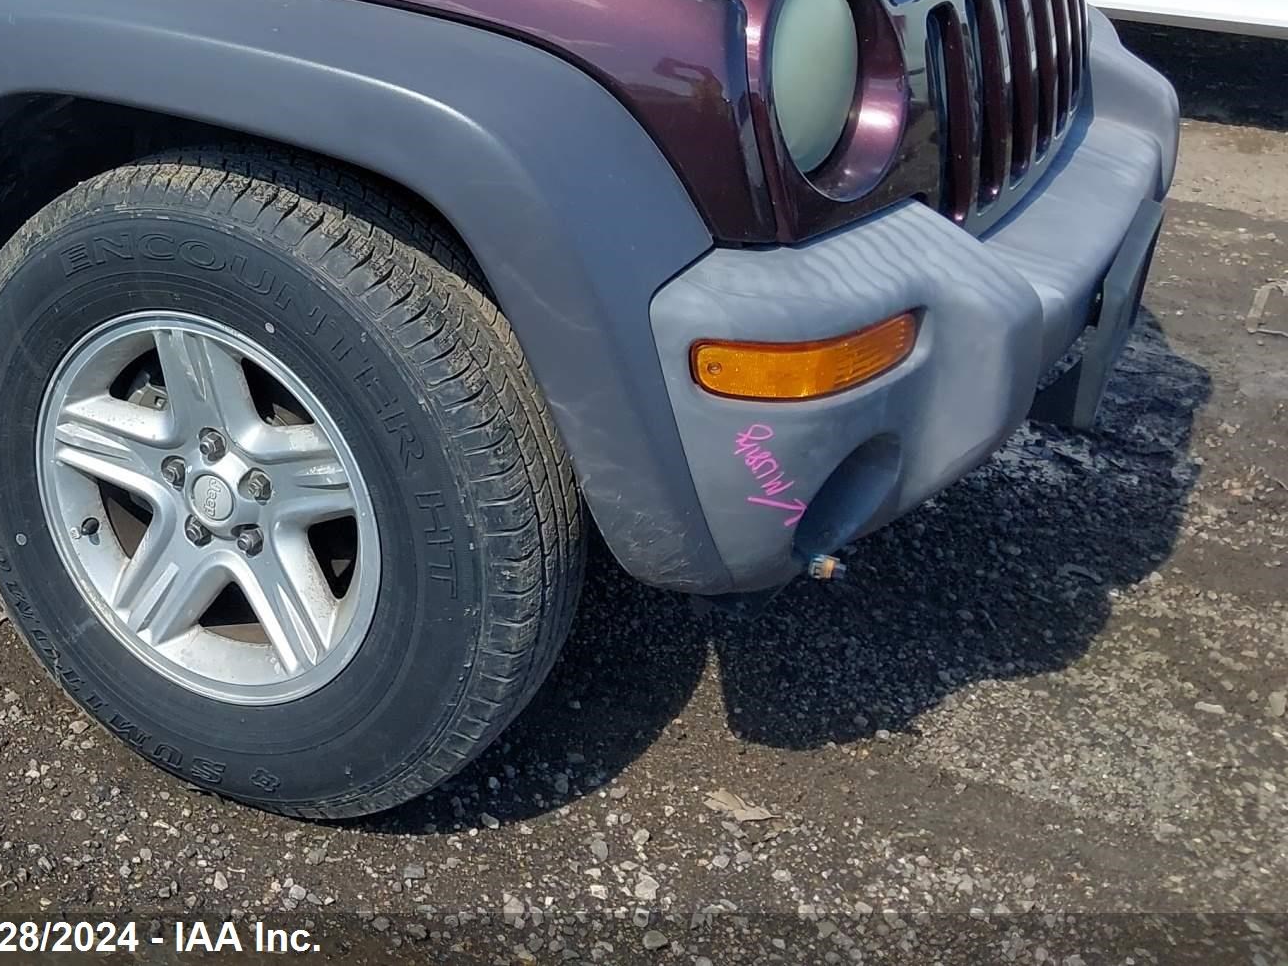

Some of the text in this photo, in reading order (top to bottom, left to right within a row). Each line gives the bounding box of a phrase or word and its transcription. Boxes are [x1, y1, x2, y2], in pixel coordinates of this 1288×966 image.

[59, 233, 460, 601] ENCOUNTER HT
[204, 478, 222, 517] Jeep
